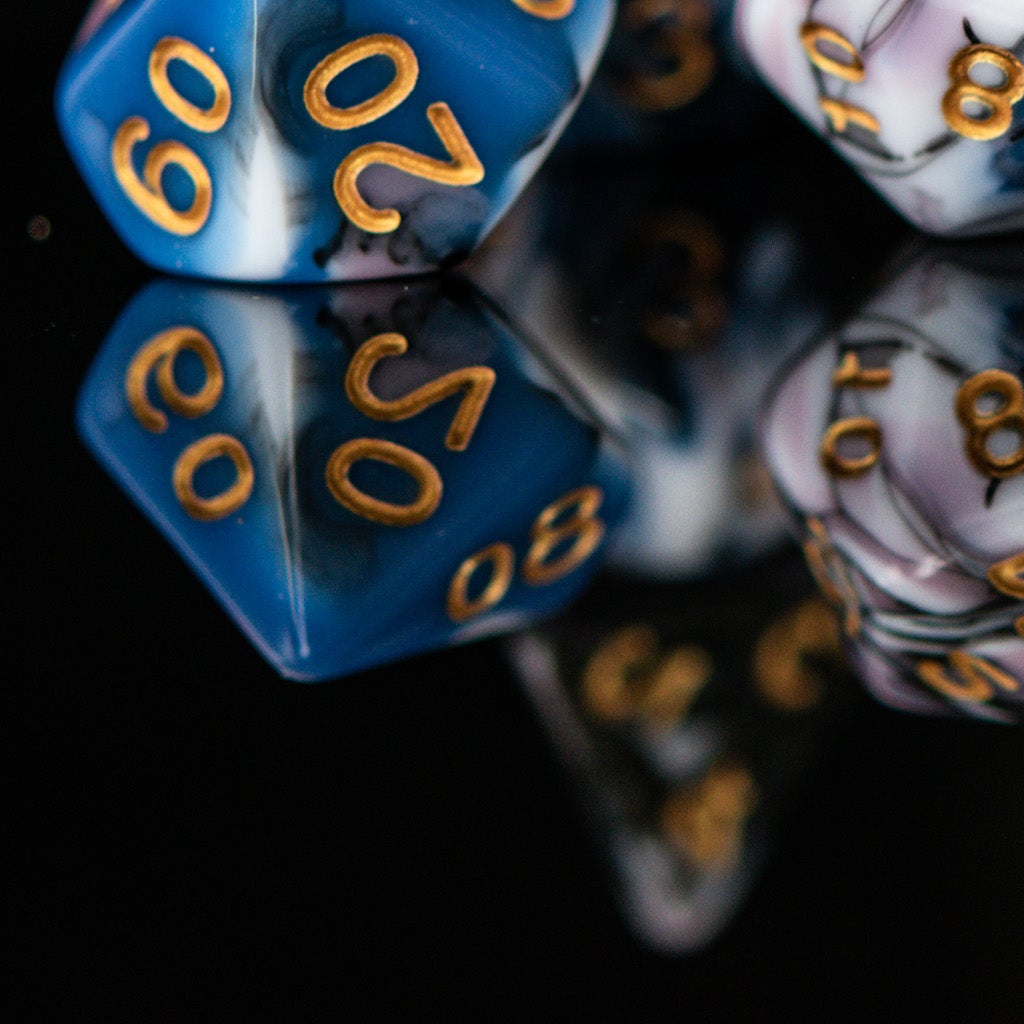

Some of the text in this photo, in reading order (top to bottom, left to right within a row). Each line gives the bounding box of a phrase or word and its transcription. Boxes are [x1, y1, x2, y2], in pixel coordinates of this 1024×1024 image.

[111, 36, 232, 236] 60
[303, 32, 486, 234] 20
[800, 21, 881, 134] 10
